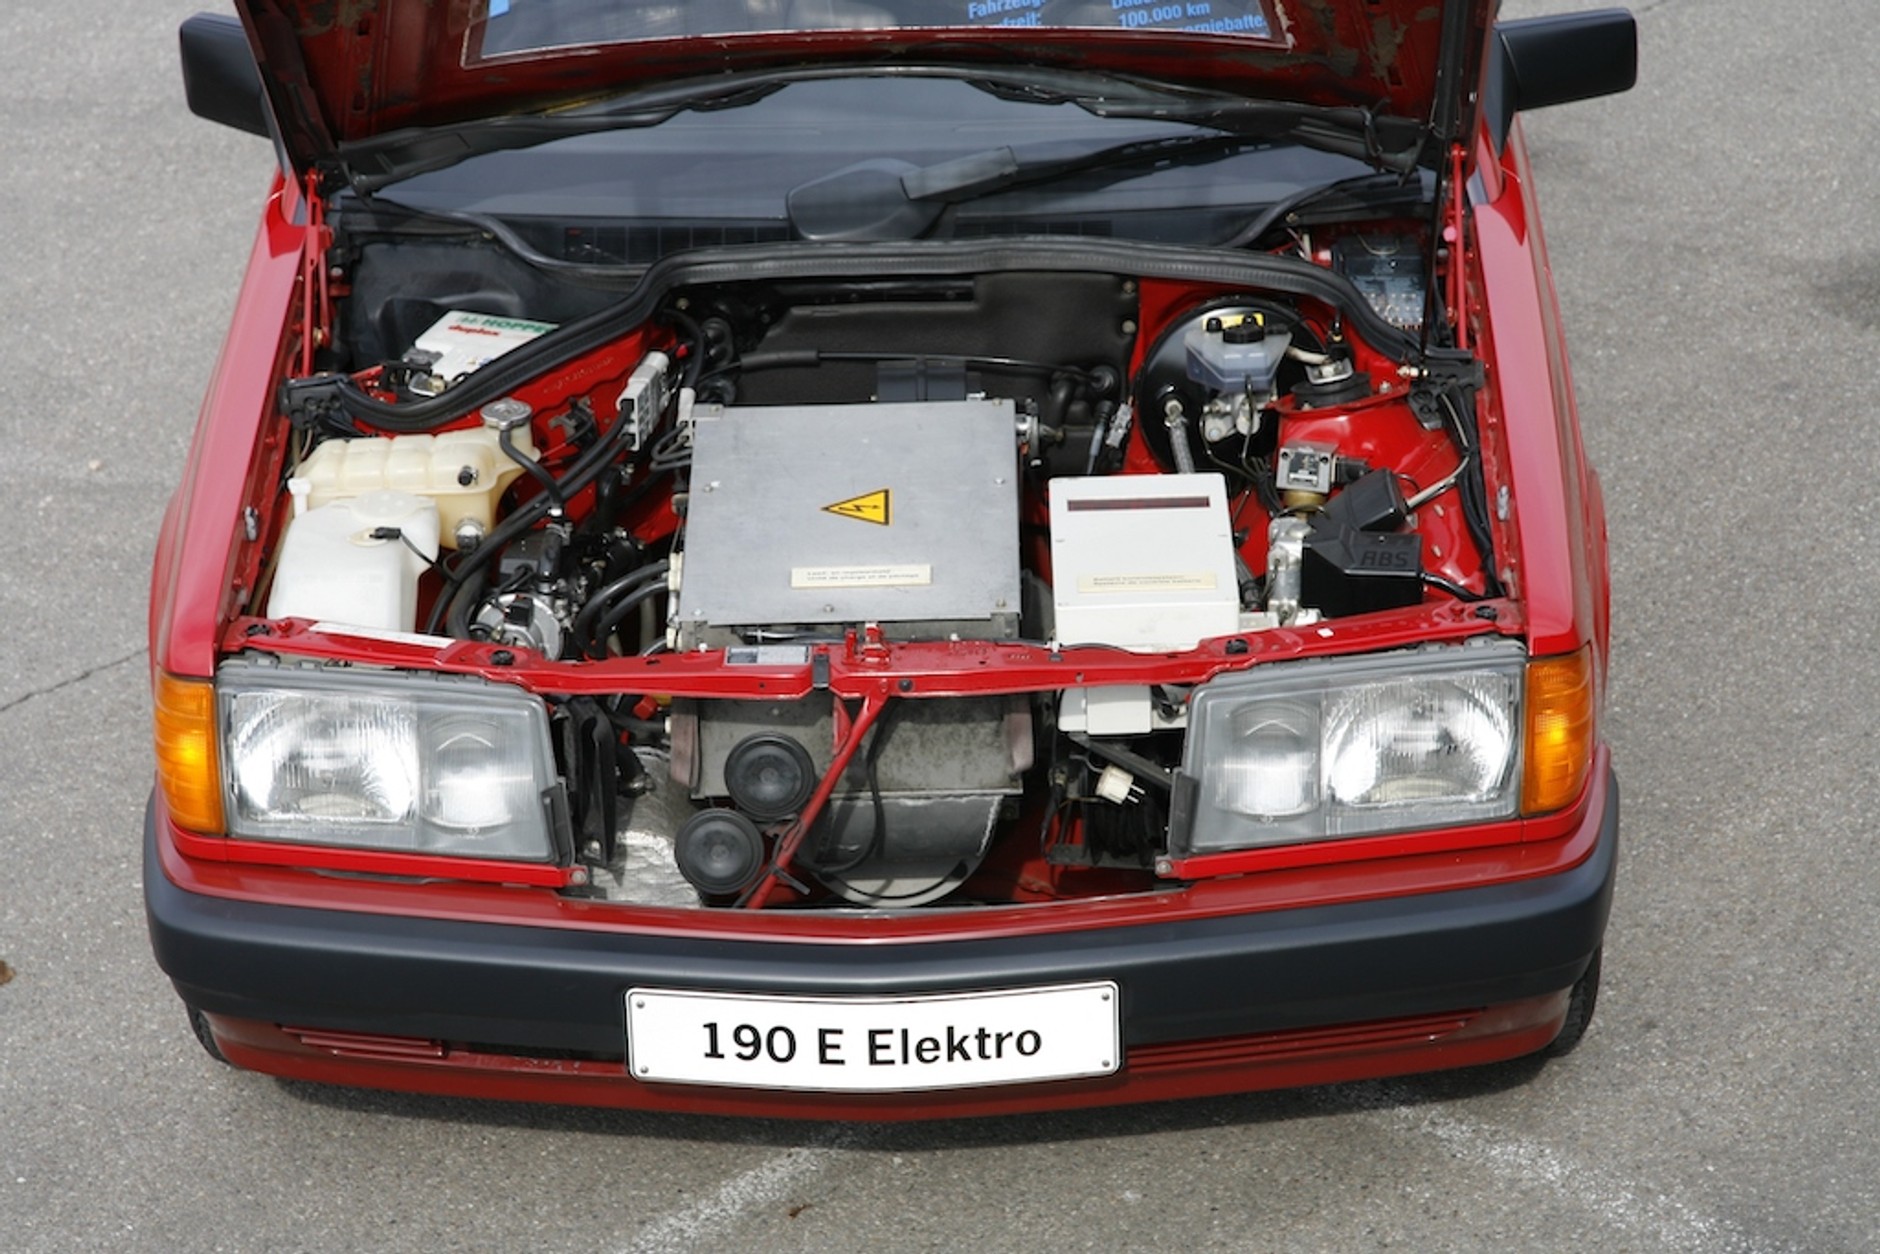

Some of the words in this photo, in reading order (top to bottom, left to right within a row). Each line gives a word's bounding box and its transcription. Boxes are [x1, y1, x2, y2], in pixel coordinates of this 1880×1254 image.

[1118, 5, 1182, 28] 100.000
[1187, 3, 1210, 17] km
[482, 318, 549, 333] HOPPE
[1360, 551, 1408, 566] ABS
[702, 1022, 797, 1064] 190
[817, 1028, 846, 1066] E
[868, 1025, 1043, 1066] Elektro
